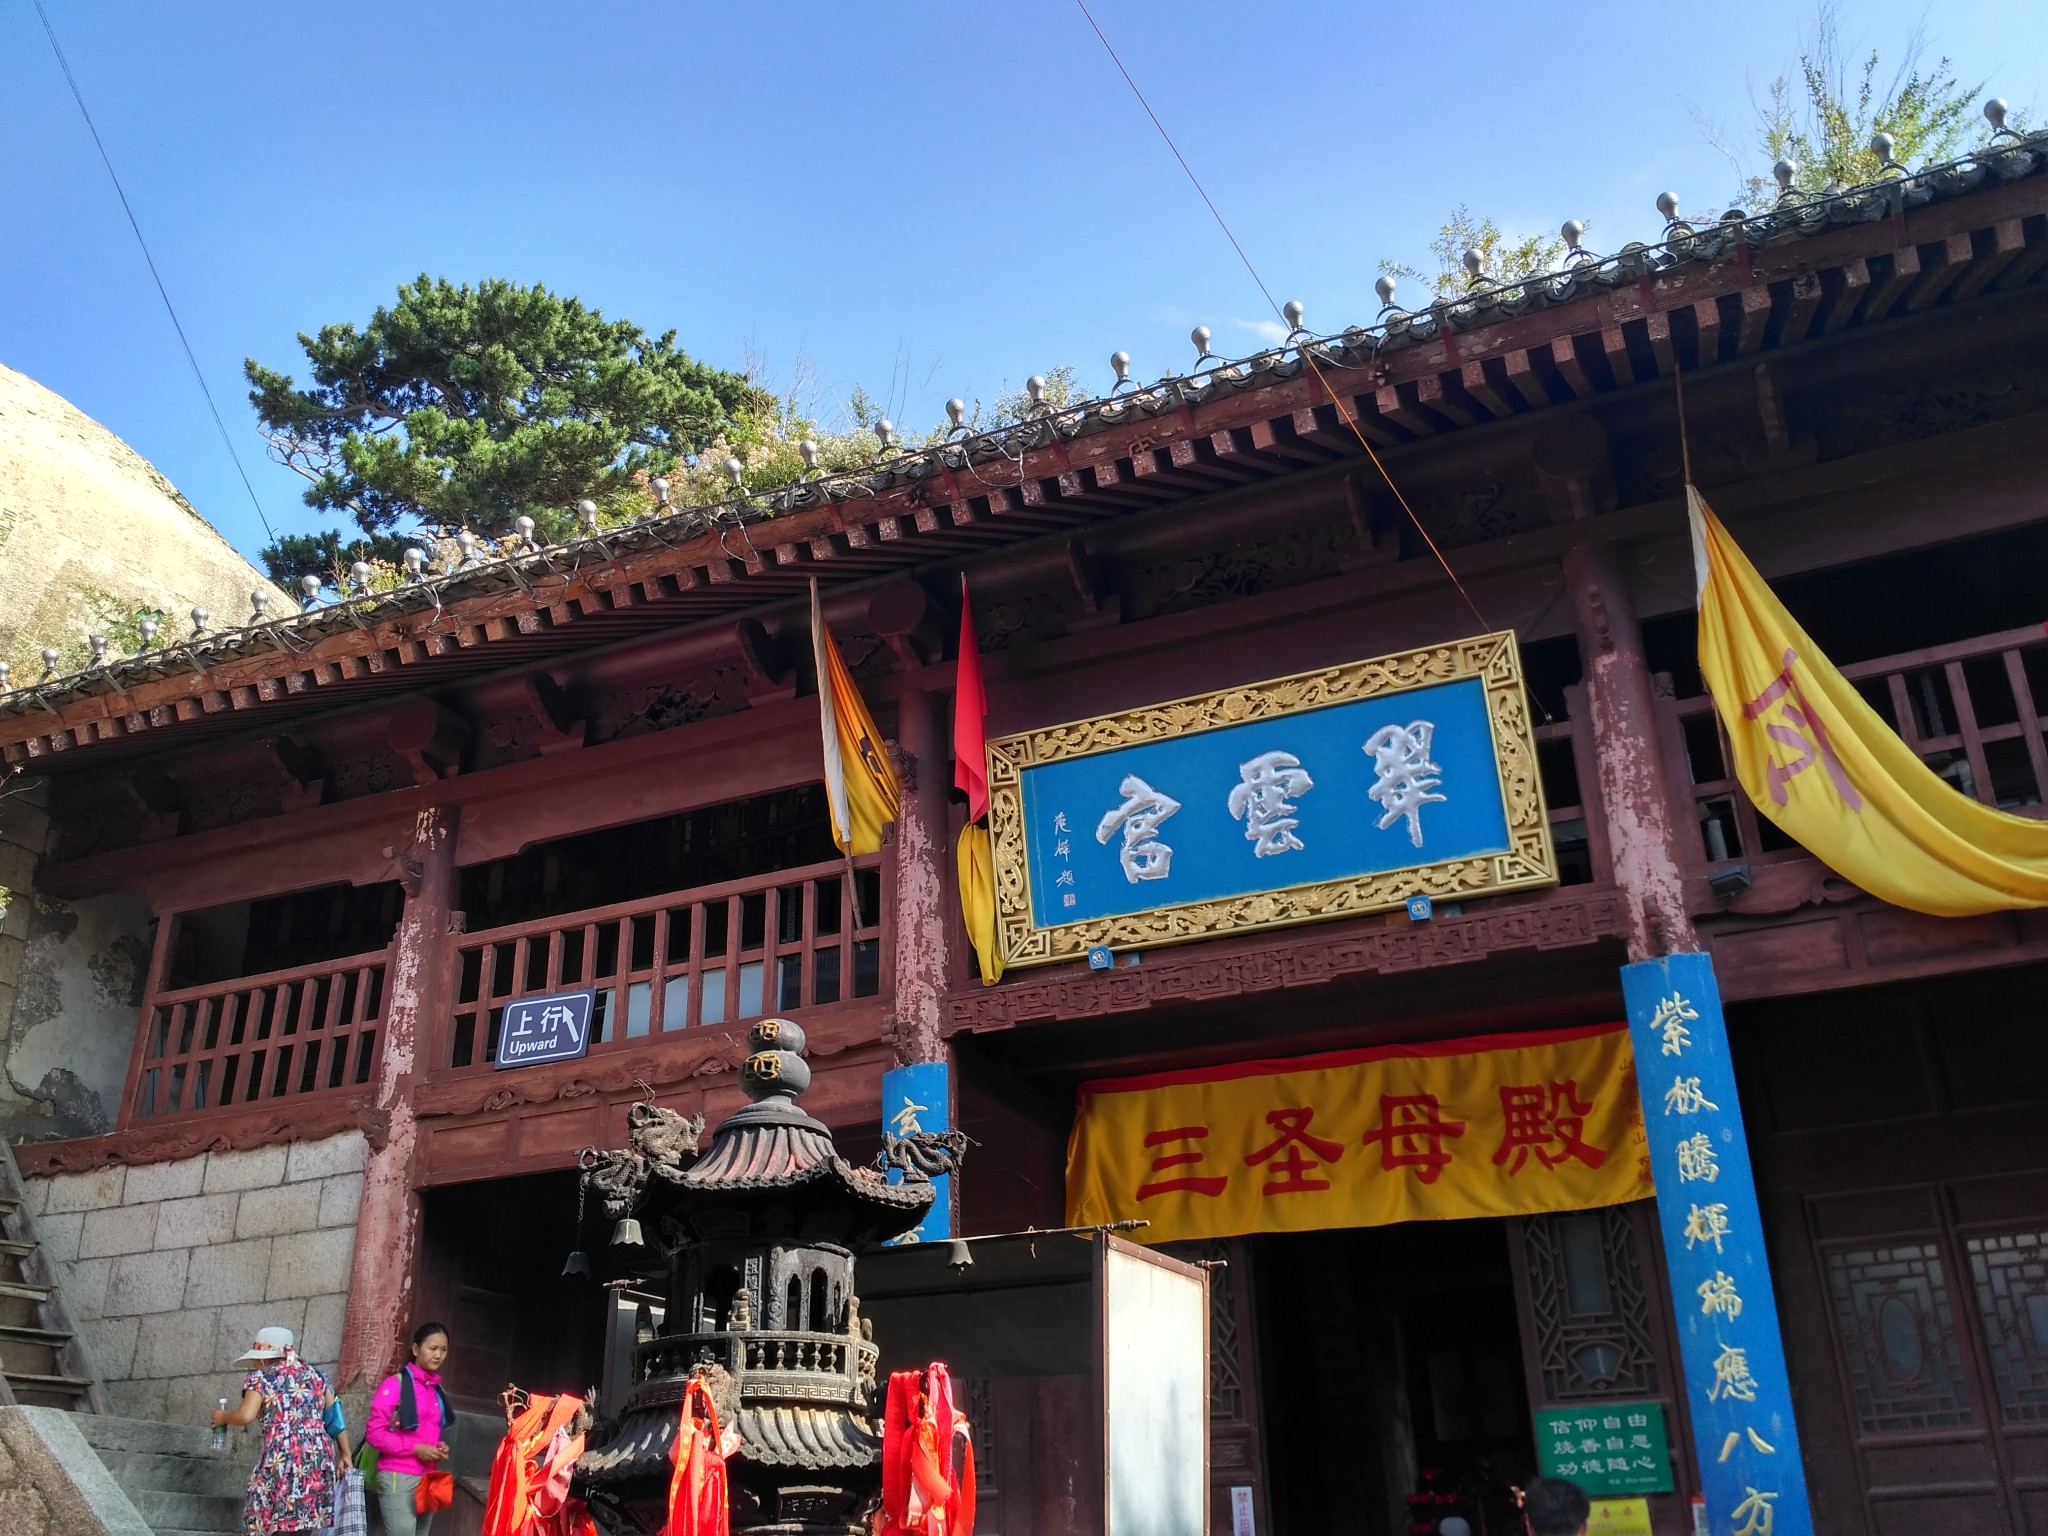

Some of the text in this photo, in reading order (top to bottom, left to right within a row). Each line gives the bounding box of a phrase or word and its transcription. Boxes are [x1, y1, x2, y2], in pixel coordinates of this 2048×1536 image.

[512, 1006, 562, 1036] 上行
[509, 1035, 558, 1056] Upward
[1136, 1079, 1606, 1201] 三圣母殿
[1549, 1413, 1647, 1434] 信仰自由
[1556, 1456, 1656, 1476] 功德随心
